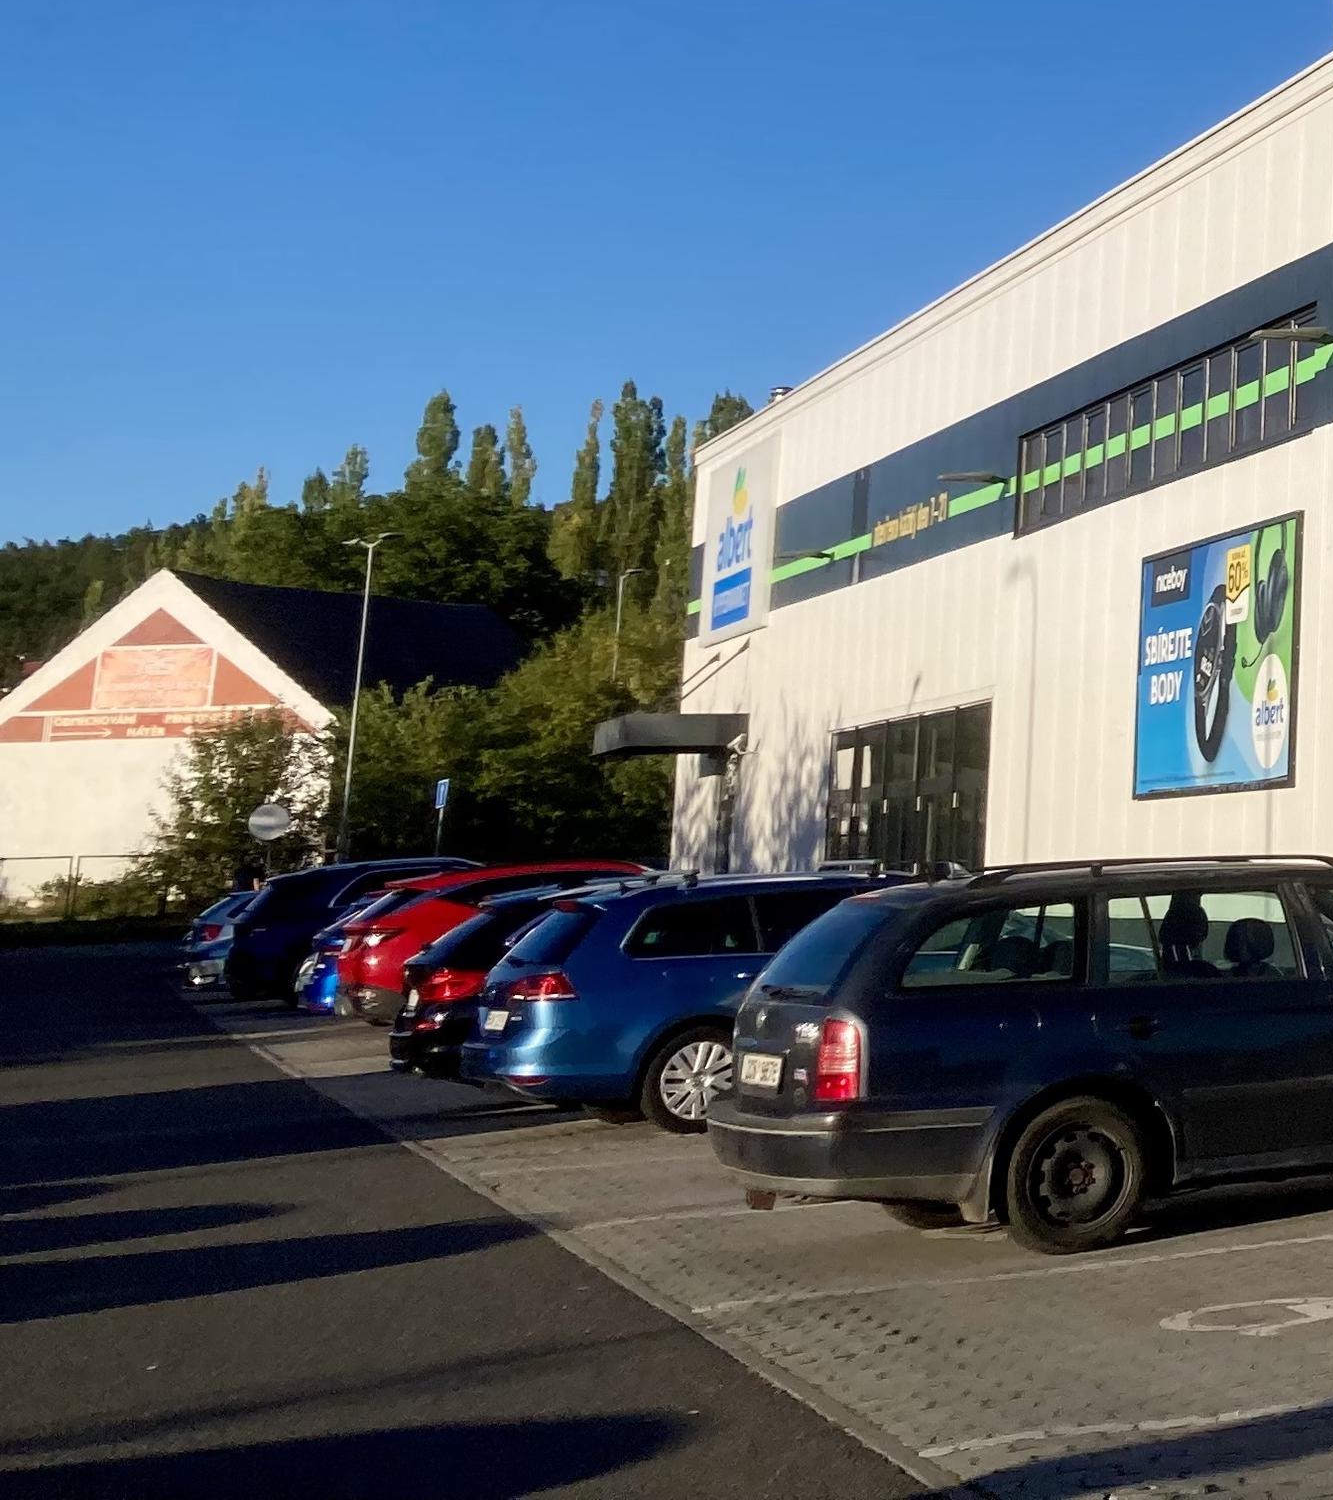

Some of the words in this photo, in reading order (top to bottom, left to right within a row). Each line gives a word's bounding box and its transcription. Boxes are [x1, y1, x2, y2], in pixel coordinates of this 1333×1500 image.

[716, 506, 753, 572] albert
[1154, 564, 1189, 594] niceboy
[1144, 626, 1193, 667] SBÍREJTE
[1150, 670, 1184, 707] BODY
[1255, 696, 1284, 727] albert
